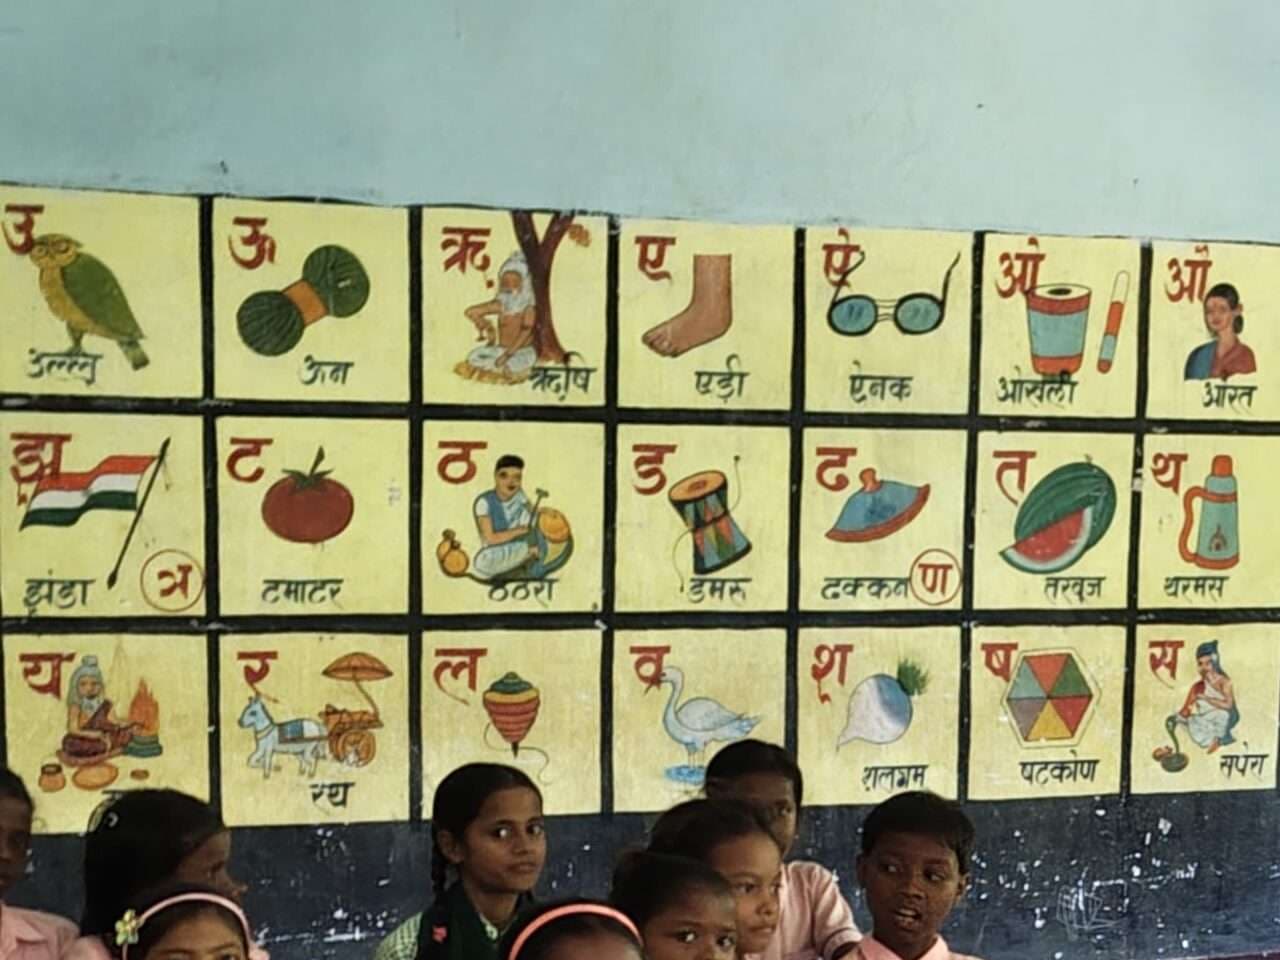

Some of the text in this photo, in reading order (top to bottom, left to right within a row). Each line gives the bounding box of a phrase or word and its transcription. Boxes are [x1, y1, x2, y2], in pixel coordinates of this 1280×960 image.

[2, 204, 44, 256] उ
[228, 216, 277, 270] ऊ
[634, 235, 676, 281] ए
[995, 236, 1045, 298] ओ
[227, 437, 273, 483] ट
[437, 440, 487, 484] ठ
[632, 444, 678, 496] ड
[816, 446, 857, 492] ढ
[992, 450, 1037, 506] त
[1151, 452, 1188, 495] थ
[261, 578, 344, 606] टमाटर
[918, 564, 953, 595] ण
[20, 652, 77, 699] य
[237, 651, 278, 703] र
[433, 648, 488, 705] ल
[811, 644, 854, 704] श
[981, 643, 1018, 682] ष
[1148, 640, 1184, 688] स
[309, 782, 355, 814] रथ
